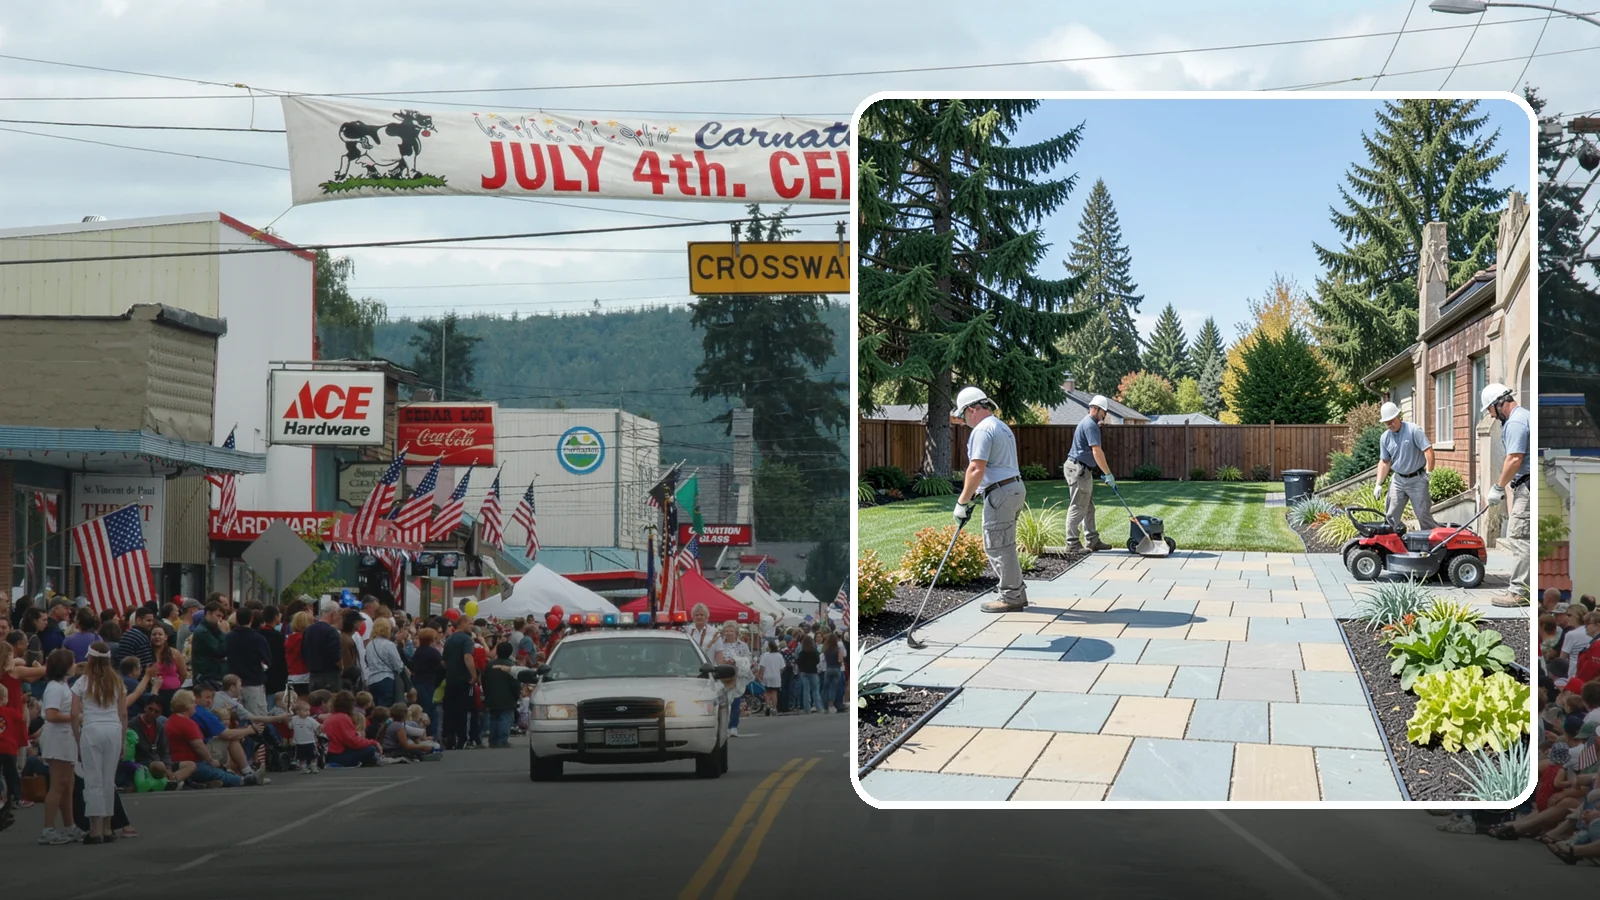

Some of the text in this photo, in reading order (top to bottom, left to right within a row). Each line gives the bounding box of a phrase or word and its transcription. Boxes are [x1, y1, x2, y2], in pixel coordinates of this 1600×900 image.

[695, 121, 850, 150] Carnat
[481, 141, 605, 191] JULY
[632, 150, 747, 198] 4th.
[697, 253, 850, 280] CROSSWA
[282, 380, 374, 420] ACE
[405, 409, 453, 423] CEDAR
[283, 421, 371, 437] Hardware
[416, 428, 477, 447] Coca-Cola
[353, 467, 385, 480] Simpl
[95, 485, 124, 495] Vincent
[126, 486, 136, 495] de
[137, 486, 155, 496] Paul
[688, 526, 741, 535] CRNATION
[699, 535, 730, 543] GLASS
